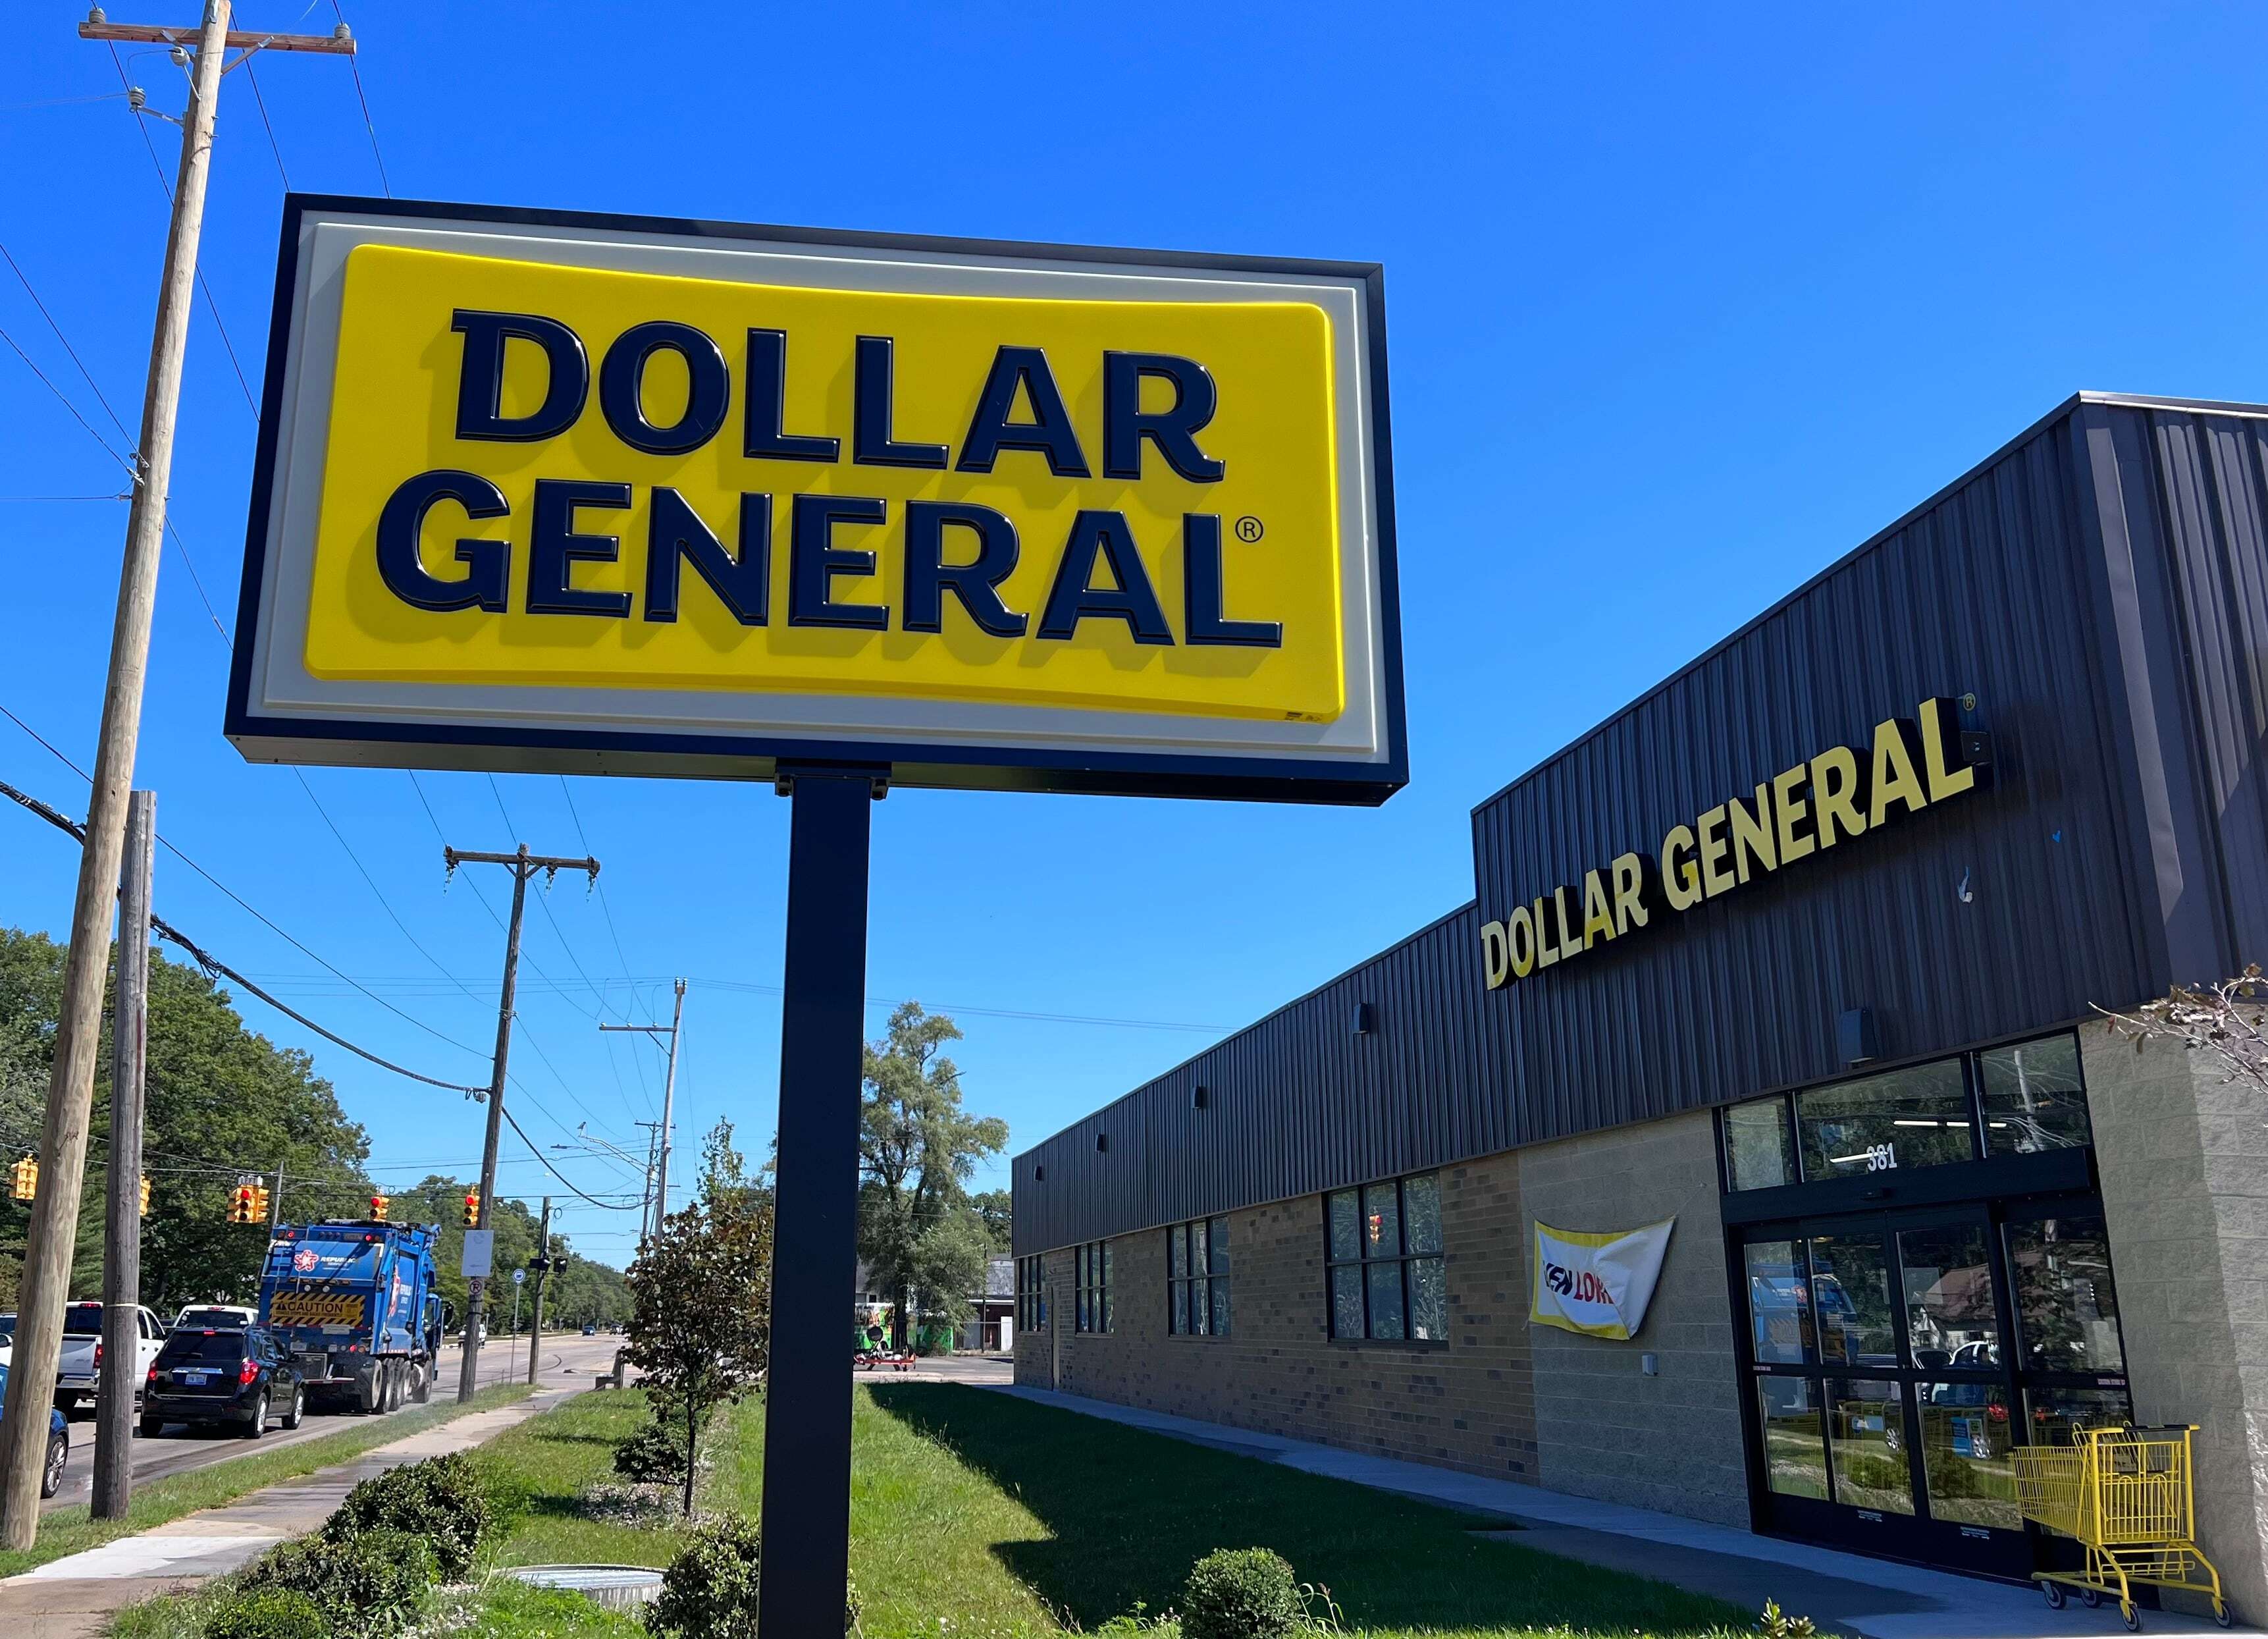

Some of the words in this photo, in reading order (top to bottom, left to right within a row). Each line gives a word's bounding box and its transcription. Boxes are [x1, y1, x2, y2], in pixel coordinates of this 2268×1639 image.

[450, 308, 1226, 483] DOLLAR
[375, 468, 1283, 648] GENERAL
[1481, 852, 1648, 990] DOLLAR
[1661, 697, 1974, 911] GENERAL
[1866, 1142, 1897, 1171] 381
[288, 1301, 343, 1313] CAUTION
